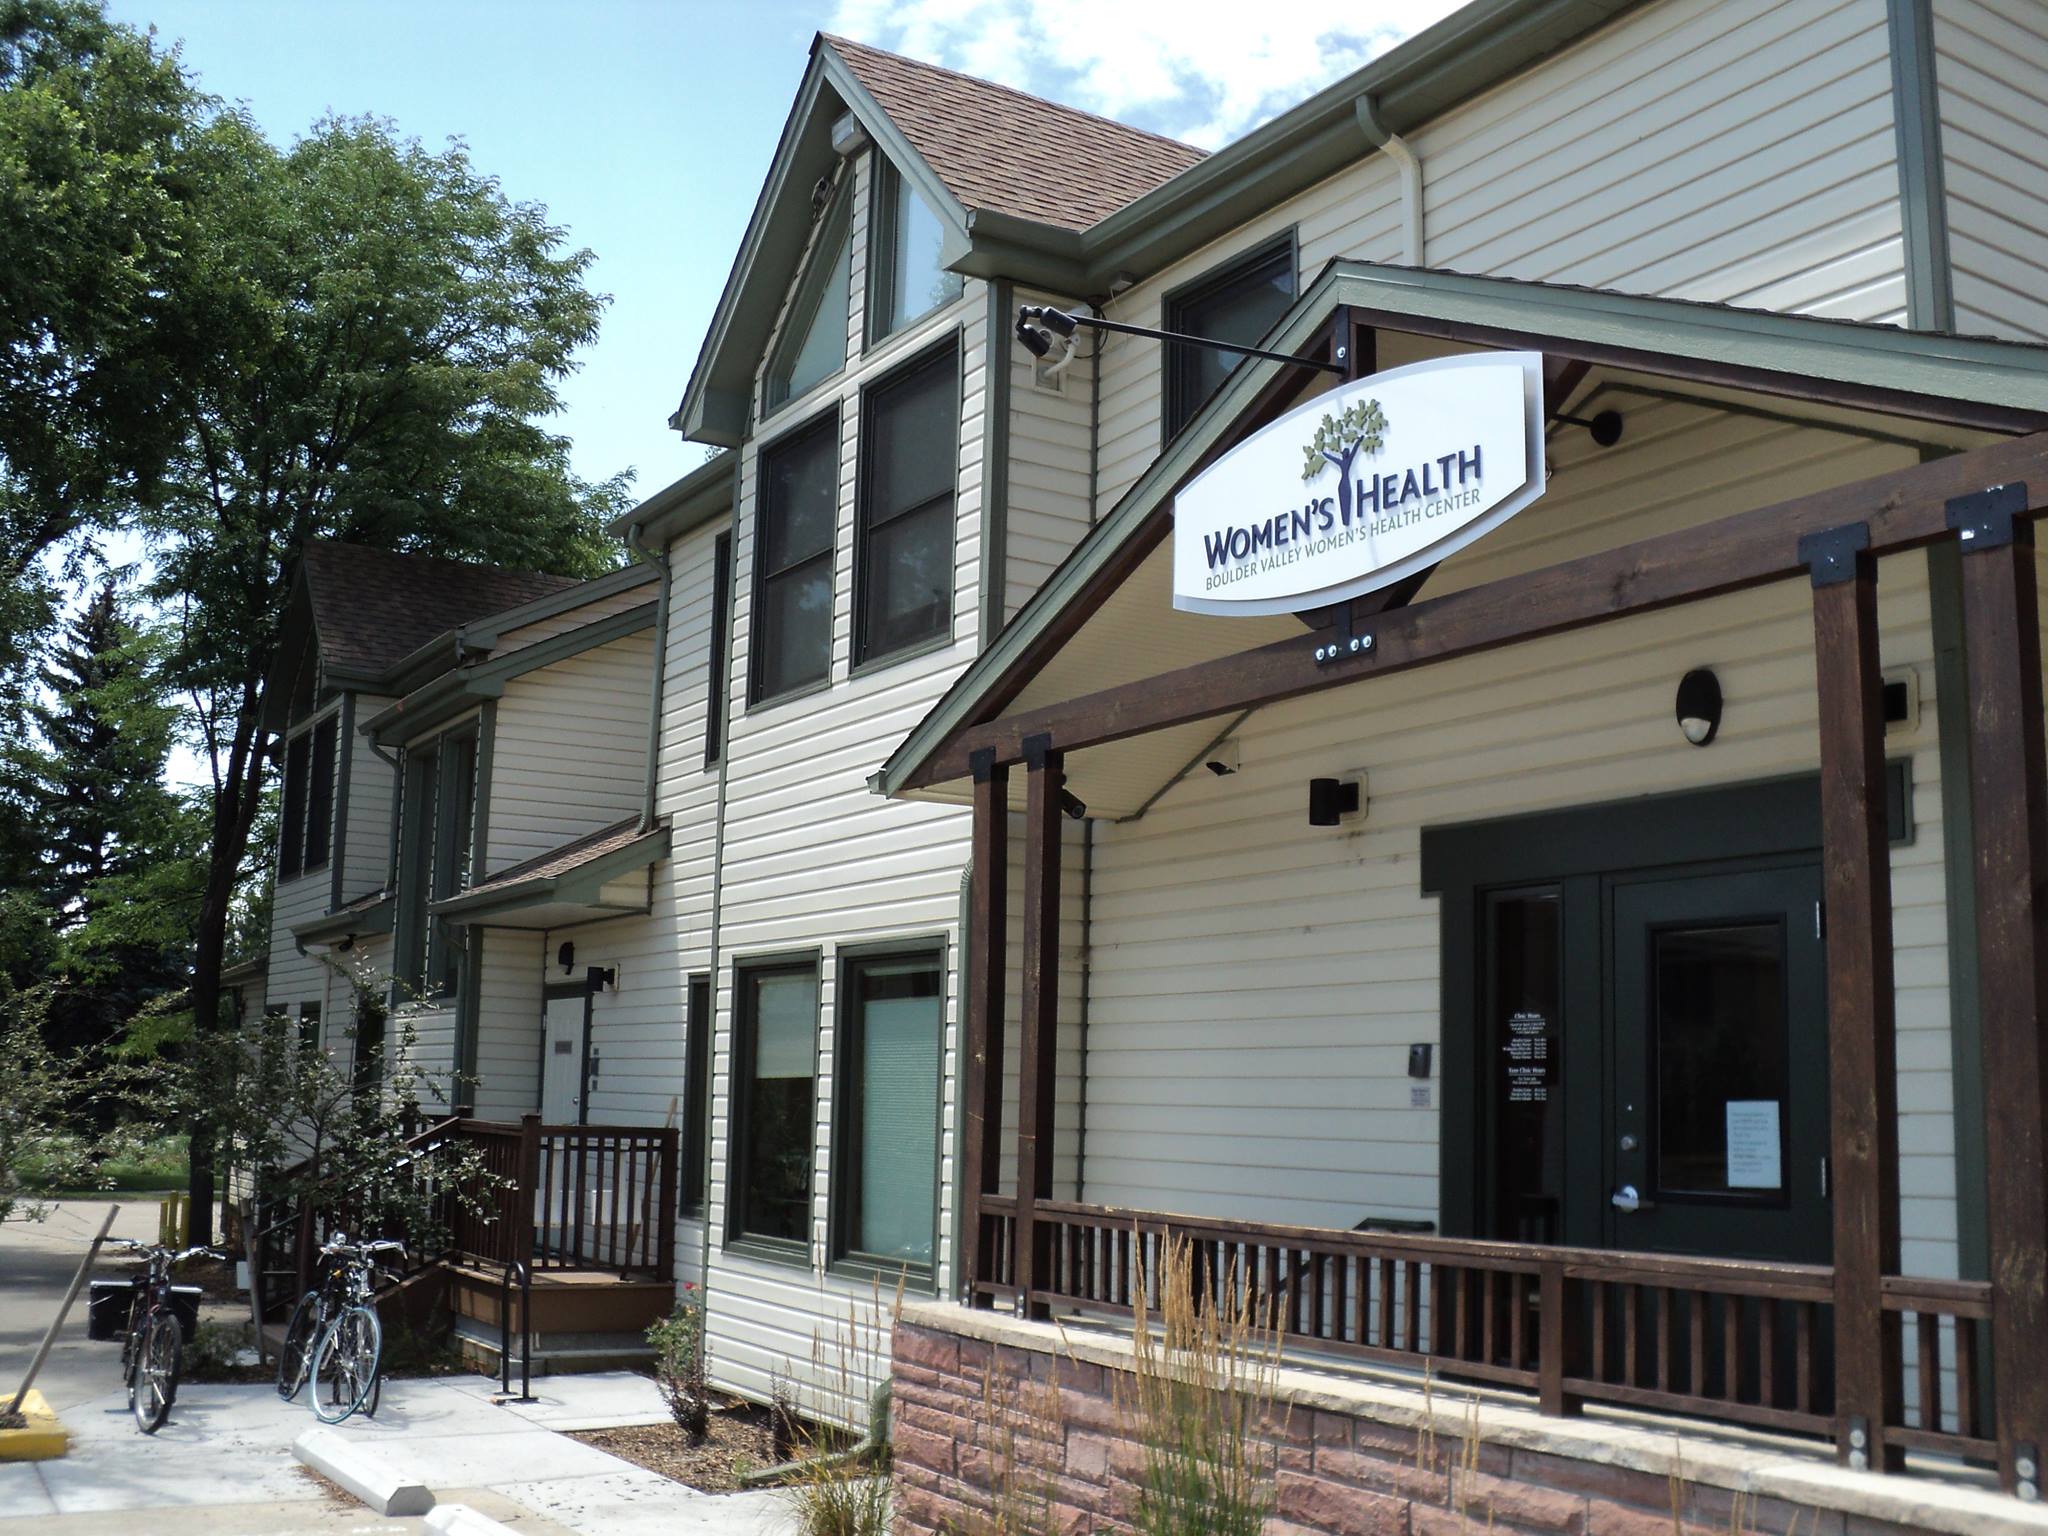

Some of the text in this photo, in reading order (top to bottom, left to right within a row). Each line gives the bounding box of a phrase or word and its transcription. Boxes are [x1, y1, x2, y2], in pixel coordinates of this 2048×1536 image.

[1204, 445, 1481, 569] WOMEN'S HEALTH
[1206, 489, 1480, 591] BOULDER VALLEY WOMEN'S HEALTH CENTER
